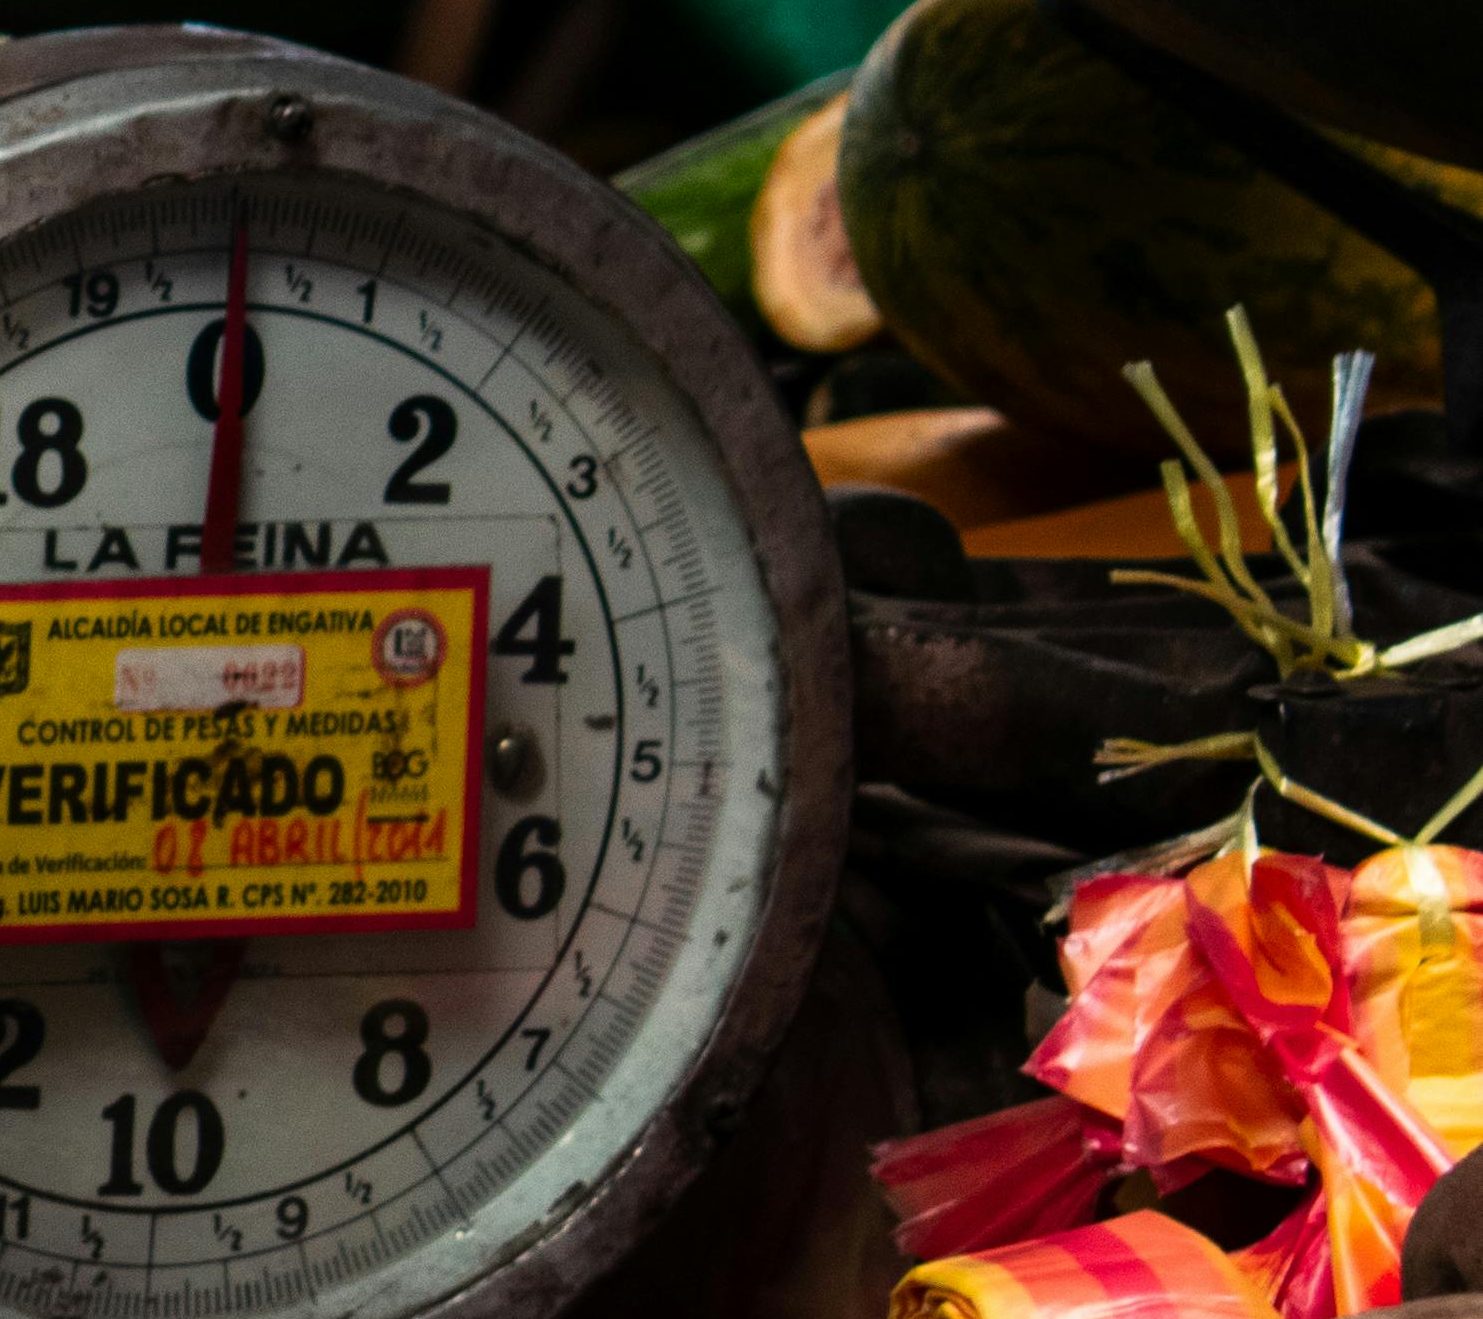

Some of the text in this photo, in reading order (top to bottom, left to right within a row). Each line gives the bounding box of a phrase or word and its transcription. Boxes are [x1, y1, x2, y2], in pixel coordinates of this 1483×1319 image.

[62, 270, 119, 318] 19
[357, 280, 377, 323] 1
[187, 317, 265, 422] 0
[383, 394, 457, 504] 2
[566, 455, 597, 499] 3
[43, 526, 140, 572] LA
[48, 609, 151, 640] ALCALDÍA
[159, 612, 228, 638] LOCAL
[236, 612, 260, 636] DE
[490, 575, 575, 684] 4
[17, 710, 398, 746] CONTROL DE PESAS Y MEDIDAS
[631, 740, 662, 782] 5
[8, 855, 29, 875] de
[494, 814, 566, 920] 6
[18, 890, 61, 915] LUIS
[67, 888, 144, 914] MARIO
[151, 885, 208, 911] SOSA
[217, 884, 236, 908] R.
[242, 883, 284, 908] CPS
[328, 878, 427, 906] 282-2010
[353, 998, 432, 1108] 8
[521, 1028, 550, 1070] 7
[97, 1089, 225, 1195] 10
[277, 1196, 309, 1240] 9
